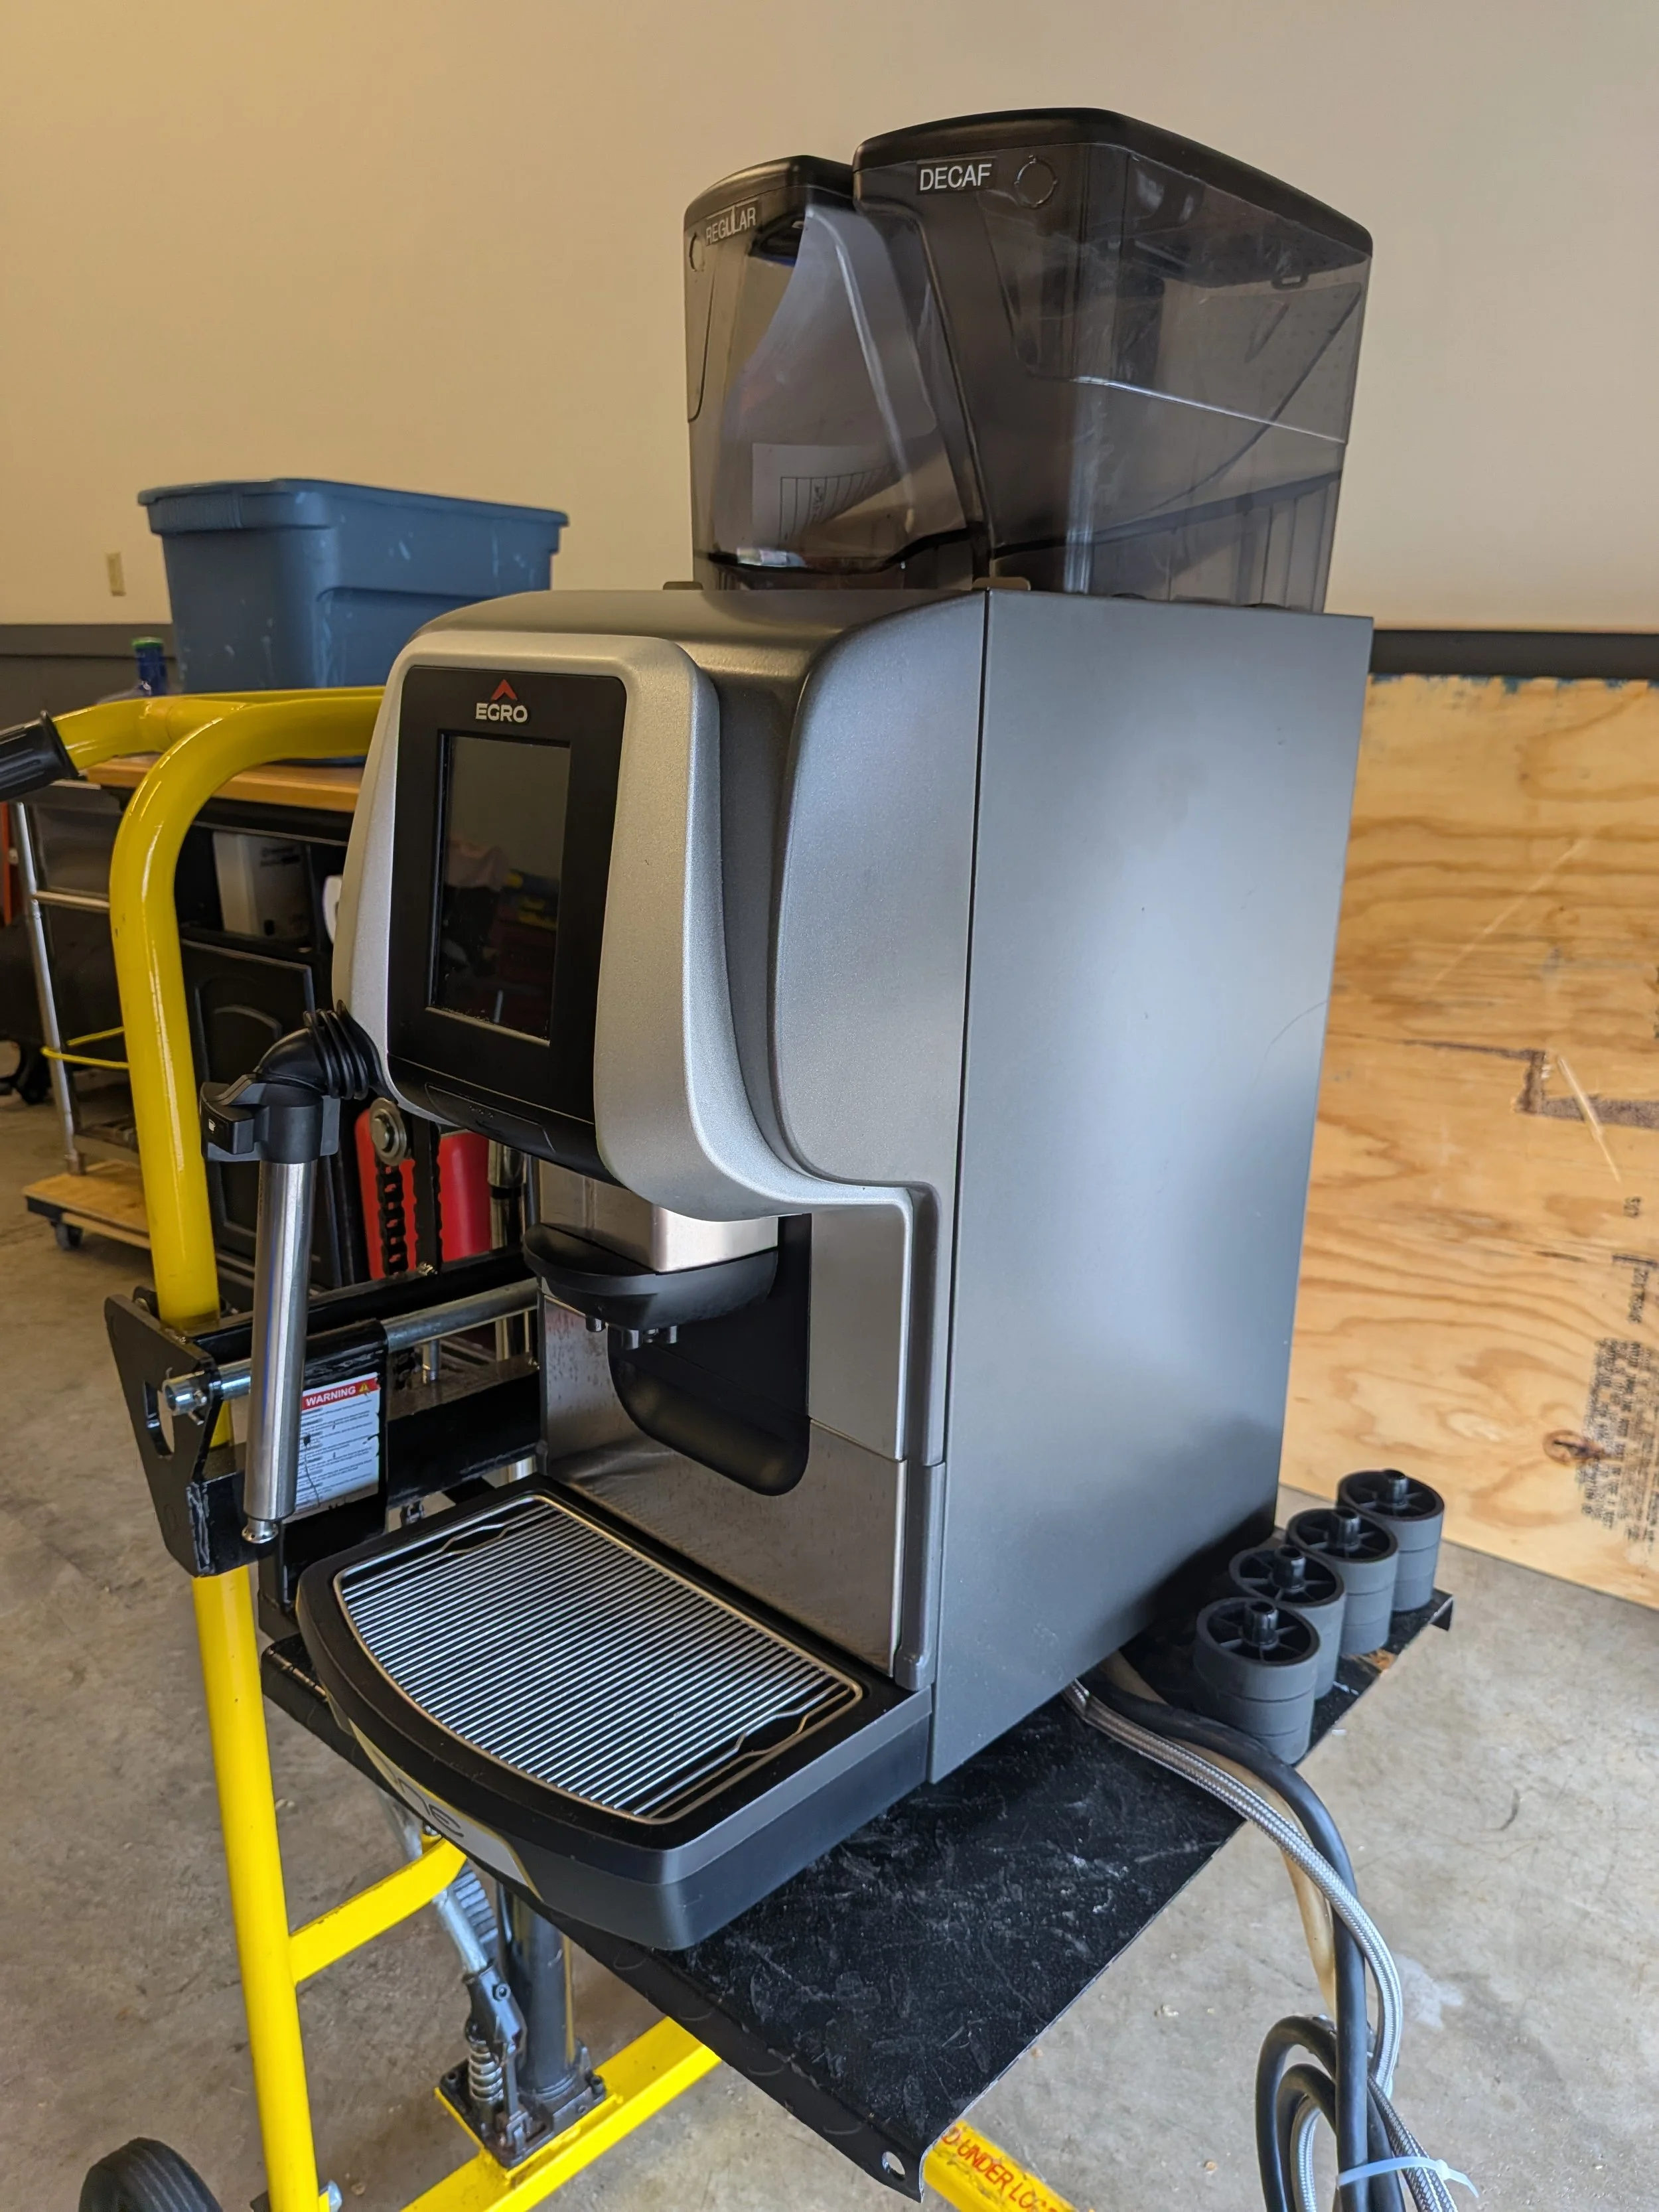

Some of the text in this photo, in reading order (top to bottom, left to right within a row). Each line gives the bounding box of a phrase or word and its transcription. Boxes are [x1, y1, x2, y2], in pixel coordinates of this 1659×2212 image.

[919, 163, 992, 191] DECAF
[705, 206, 756, 246] REGULAR
[475, 702, 528, 723] EGRO
[306, 1386, 356, 1406] WARNING
[958, 2138, 1014, 2190] UNDER
